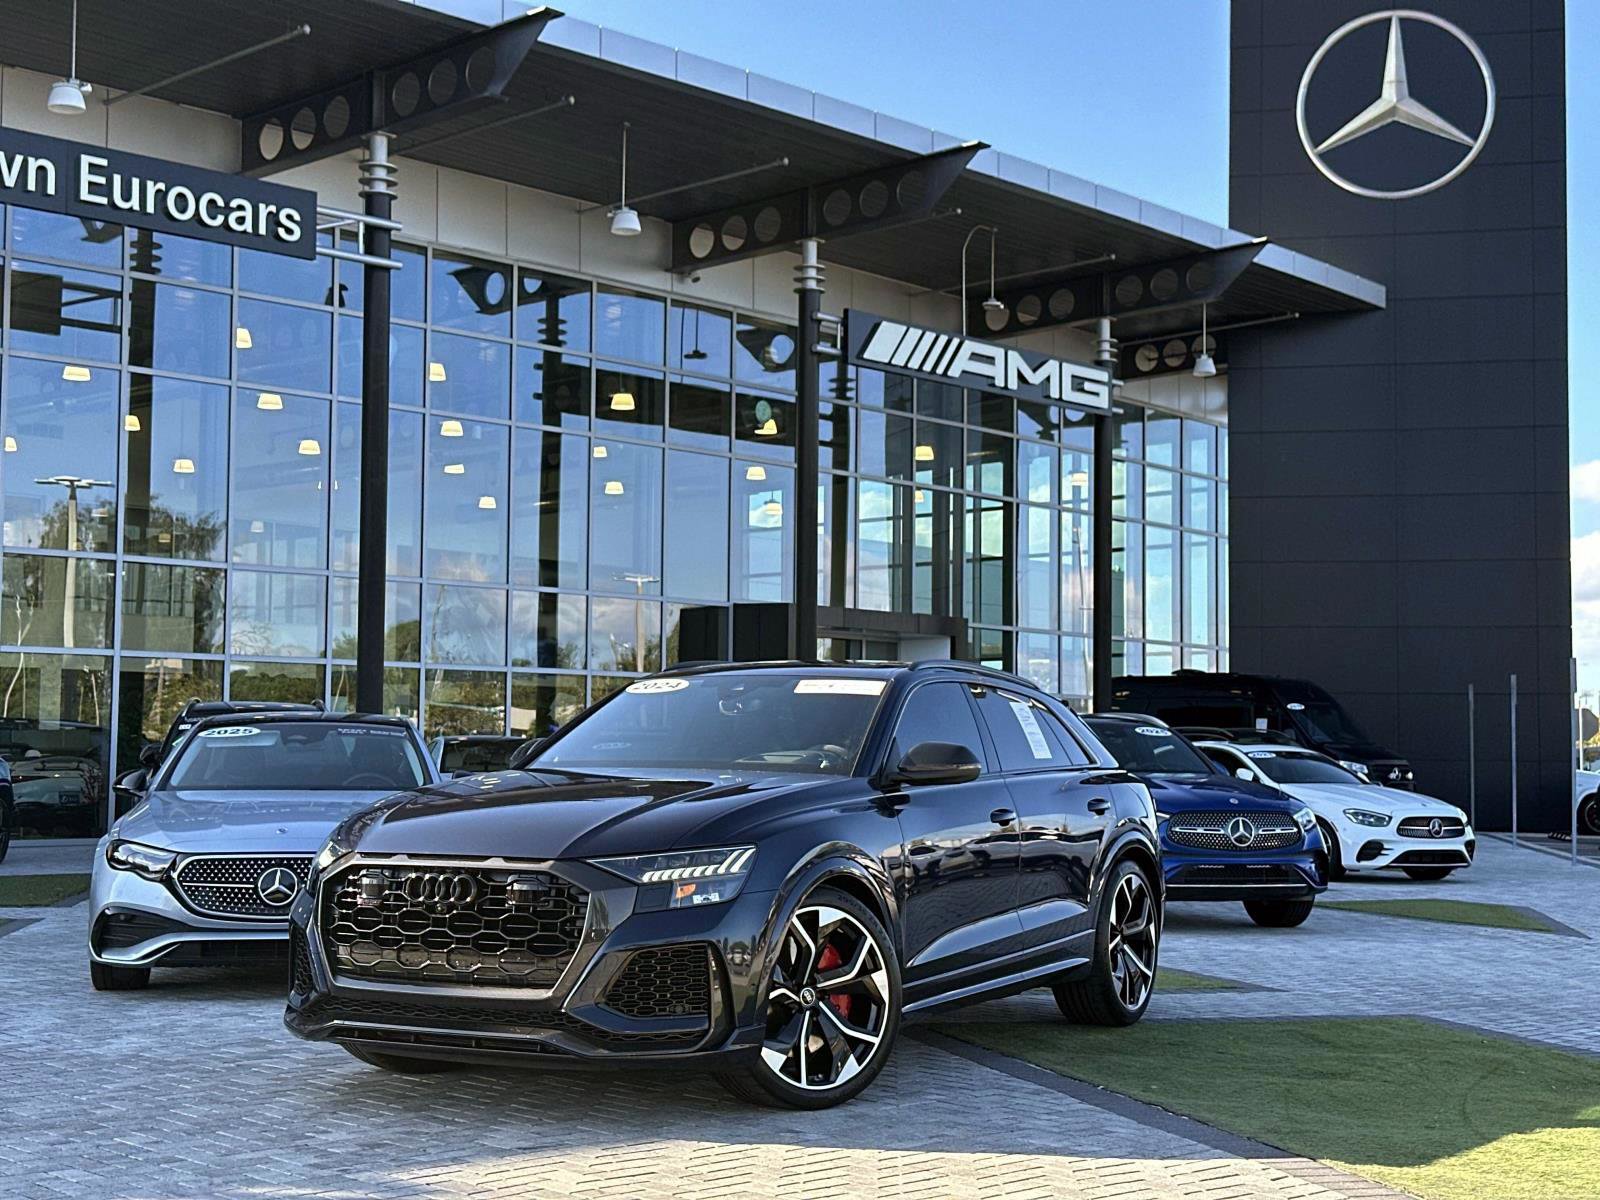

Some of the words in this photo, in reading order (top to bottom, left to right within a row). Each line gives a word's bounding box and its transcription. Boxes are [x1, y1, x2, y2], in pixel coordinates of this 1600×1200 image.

[79, 153, 301, 242] Eurocars
[947, 339, 1109, 409] AMG
[204, 728, 253, 736] 2025
